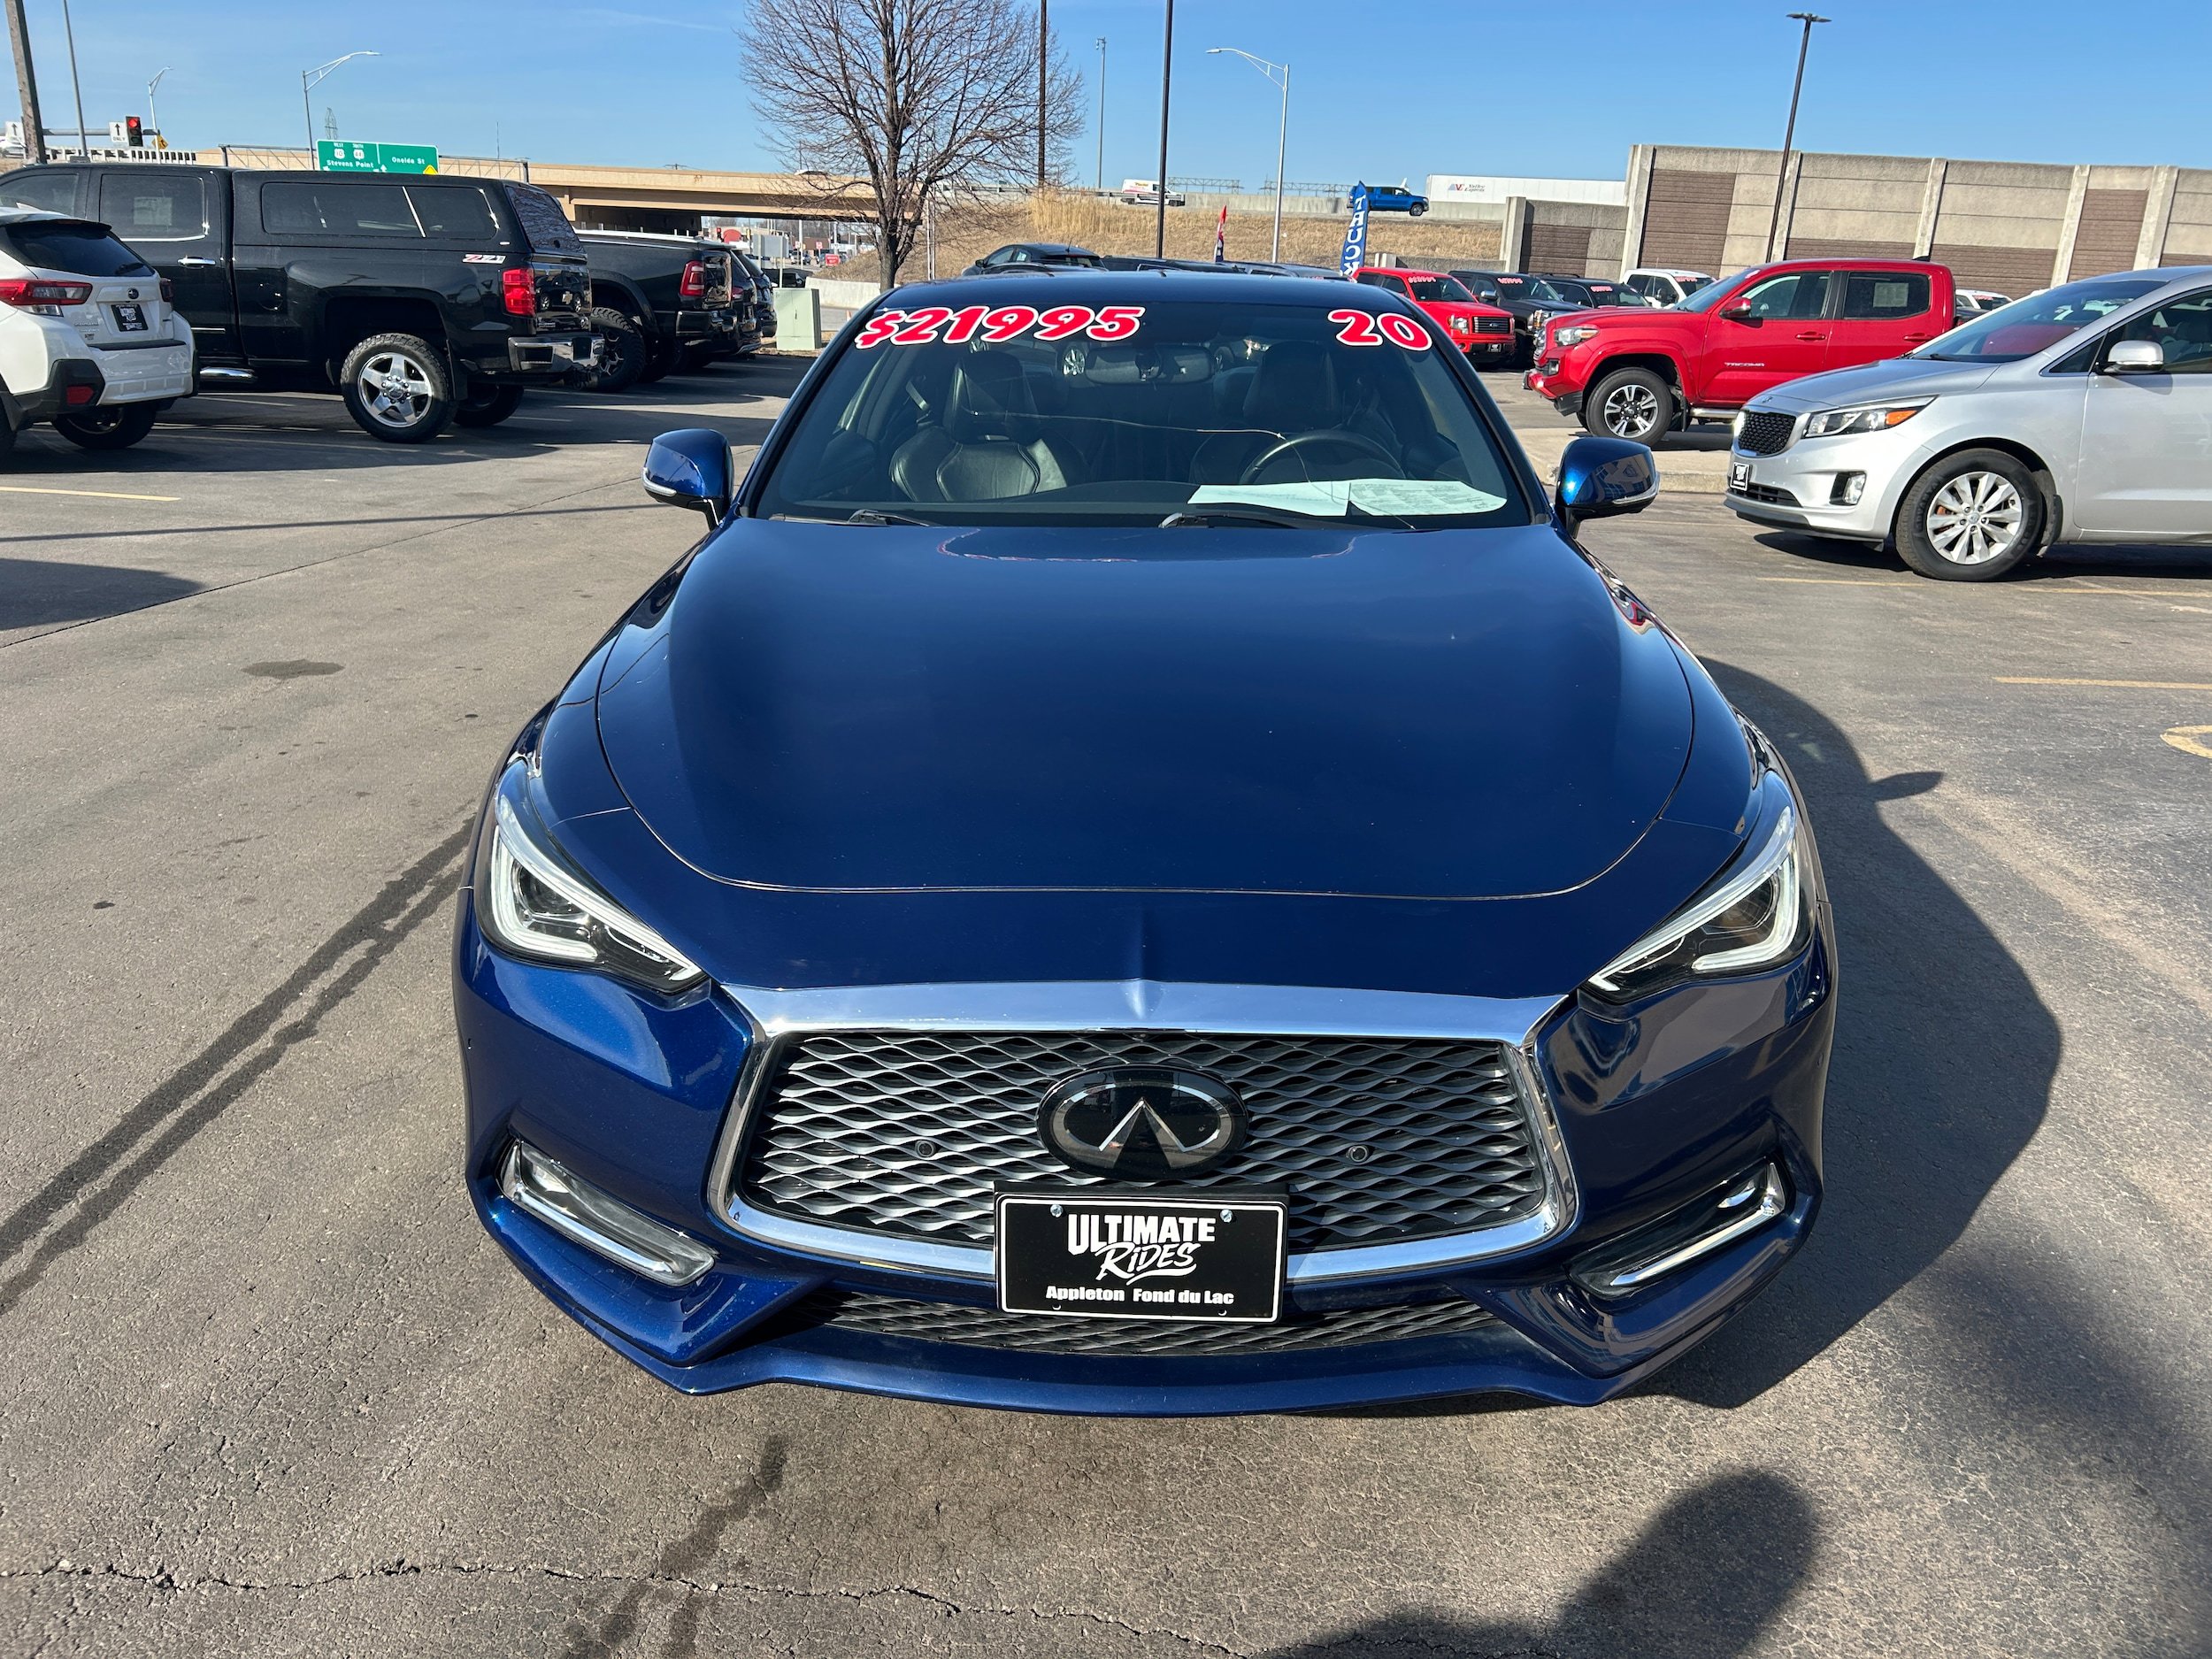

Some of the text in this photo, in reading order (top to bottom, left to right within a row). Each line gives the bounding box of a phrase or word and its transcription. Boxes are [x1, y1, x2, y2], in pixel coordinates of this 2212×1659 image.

[462, 253, 507, 265] Z71
[855, 305, 1432, 351] $21995 20
[1067, 1213, 1217, 1256] ULTIMATE
[1046, 1286, 1234, 1305] Appleton Fond du Lac
